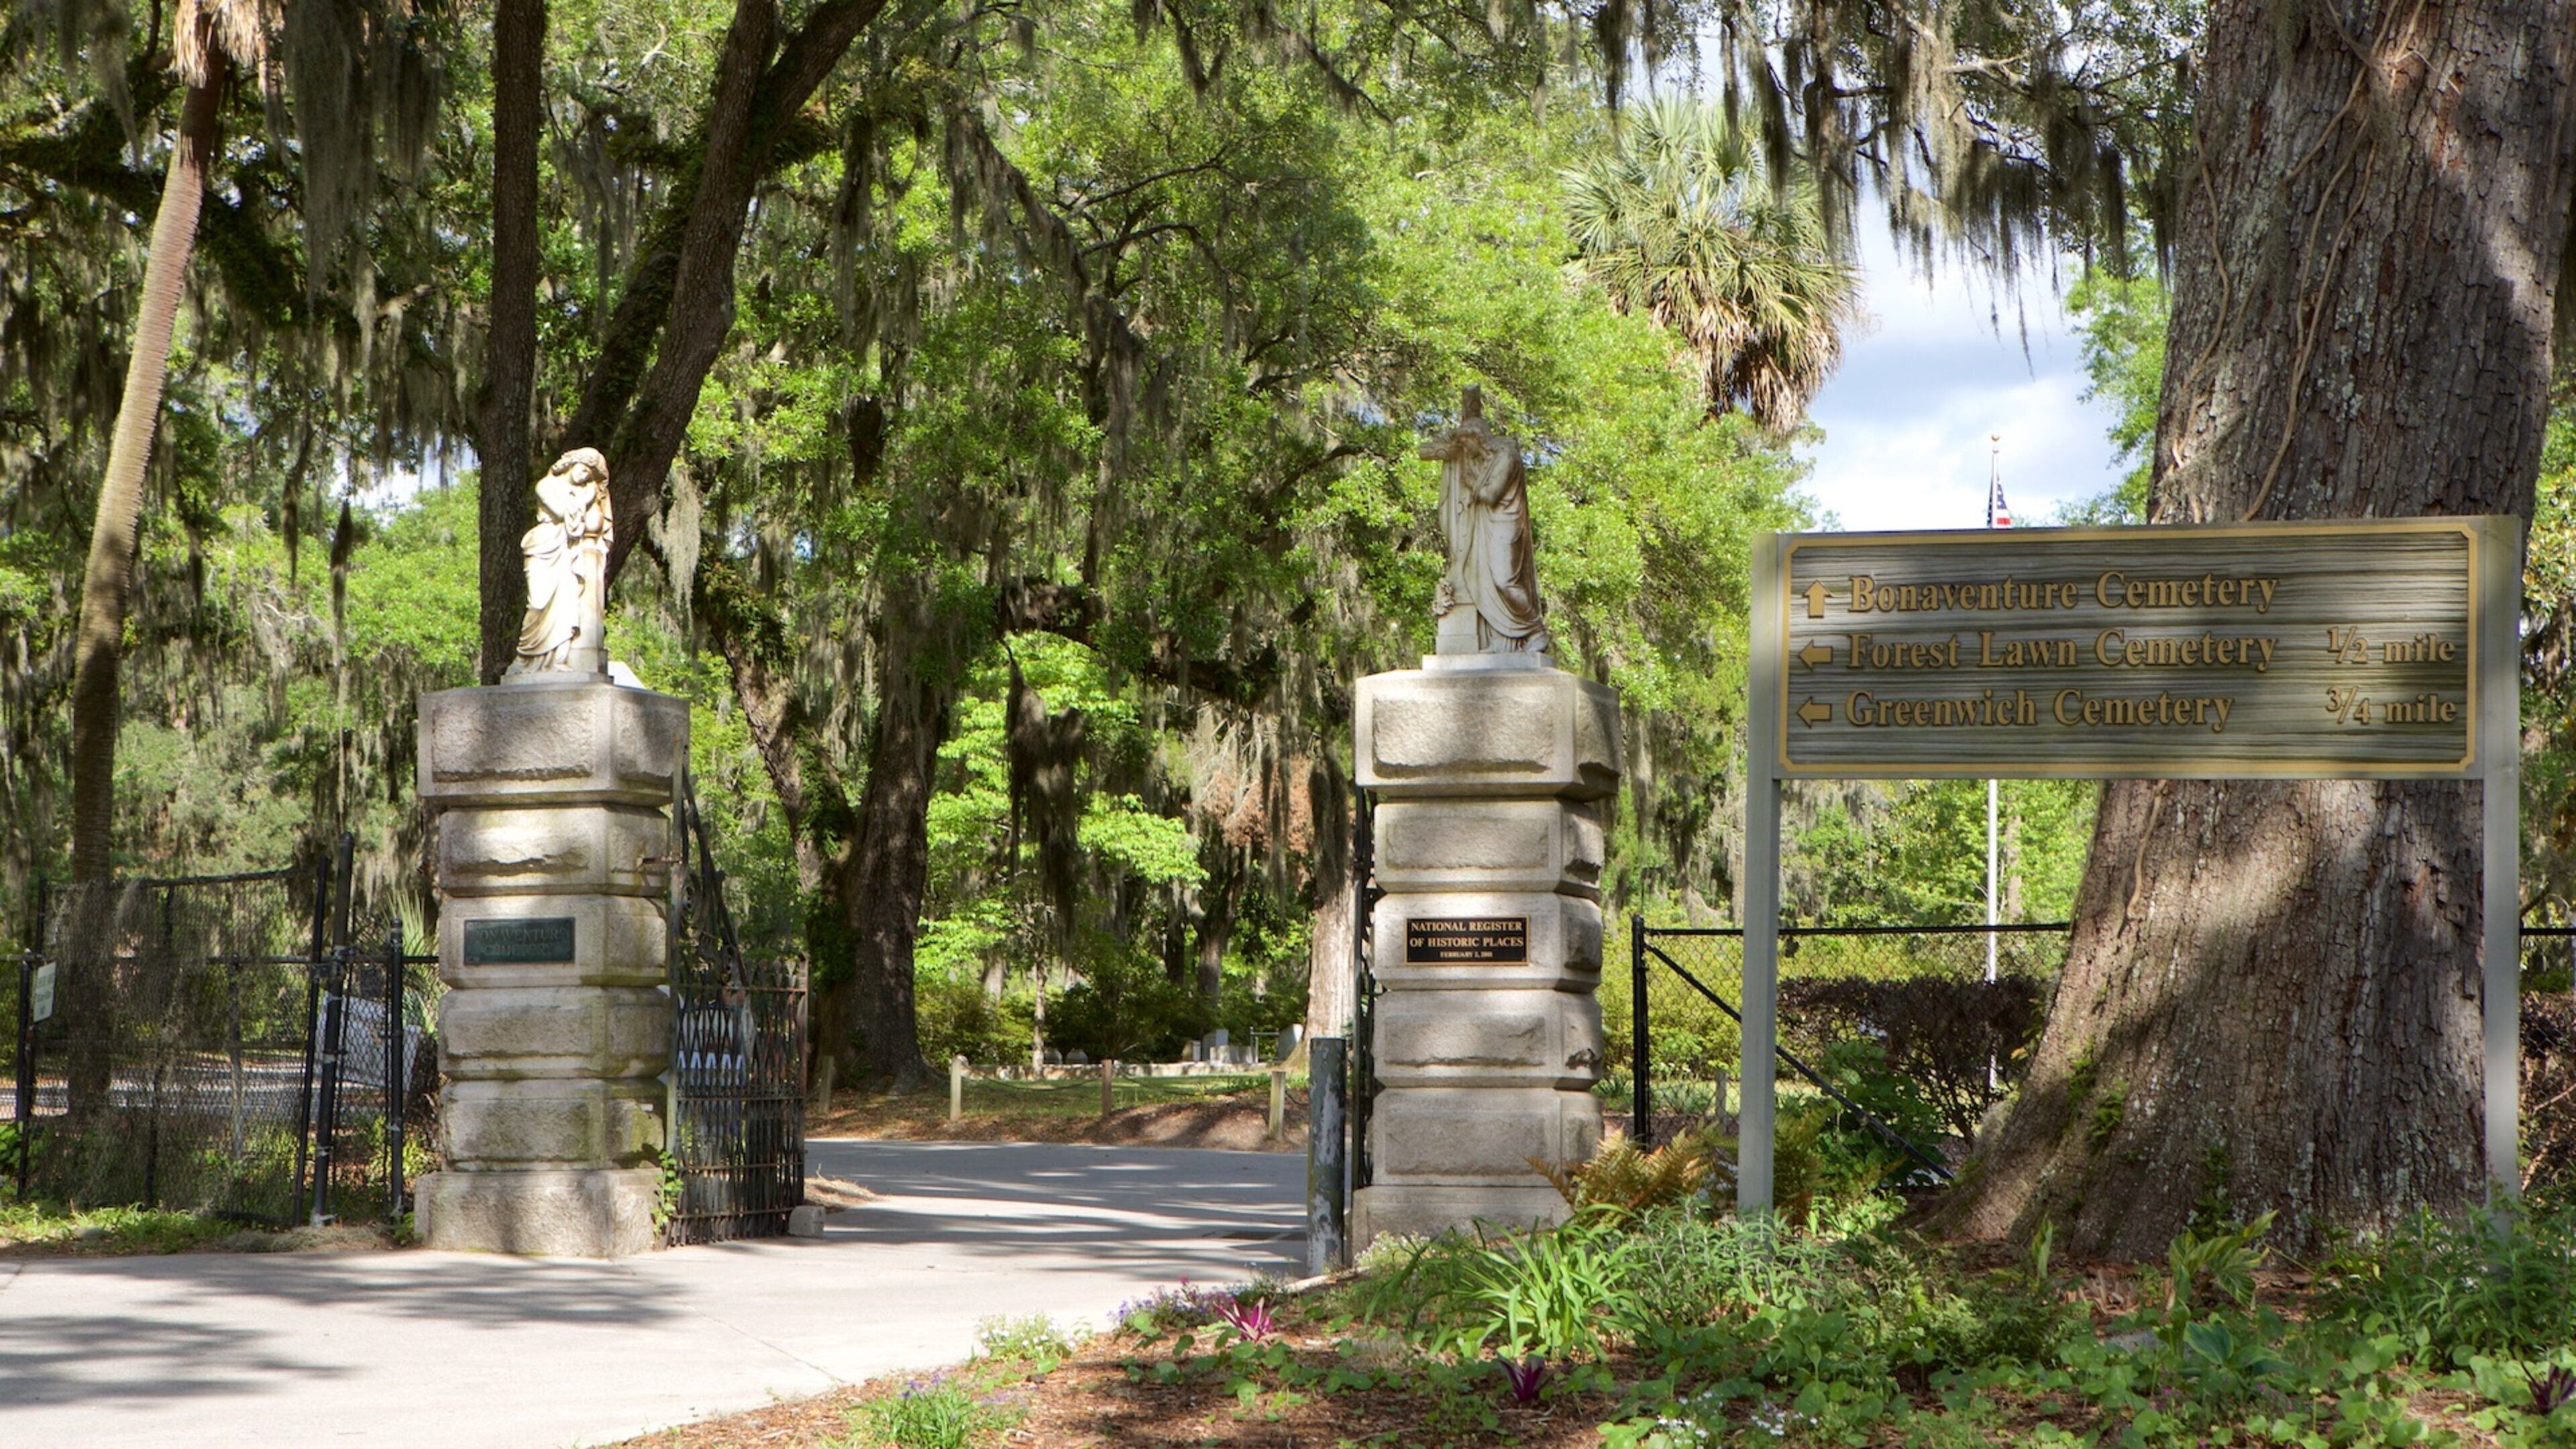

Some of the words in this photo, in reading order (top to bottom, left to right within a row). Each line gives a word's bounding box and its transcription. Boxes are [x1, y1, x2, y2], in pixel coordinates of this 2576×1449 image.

[1847, 575, 2078, 612] Bonaventure
[2095, 570, 2278, 614] Cemetery
[1846, 632, 1962, 668] Forest
[1976, 630, 2078, 667] Lawn
[2094, 629, 2278, 672] Cemetery
[2383, 633, 2456, 663] mile
[1845, 688, 2037, 727] Greenwich
[2053, 688, 2235, 733] Cemetery
[2385, 693, 2458, 724] mile
[472, 927, 568, 941] ONAVENTUR
[1411, 921, 1466, 932] NATIONAL
[1468, 920, 1523, 931] REGISTER
[1409, 937, 1425, 947] OF
[1428, 937, 1479, 947] HISTORIC
[1483, 937, 1524, 947] PLACES
